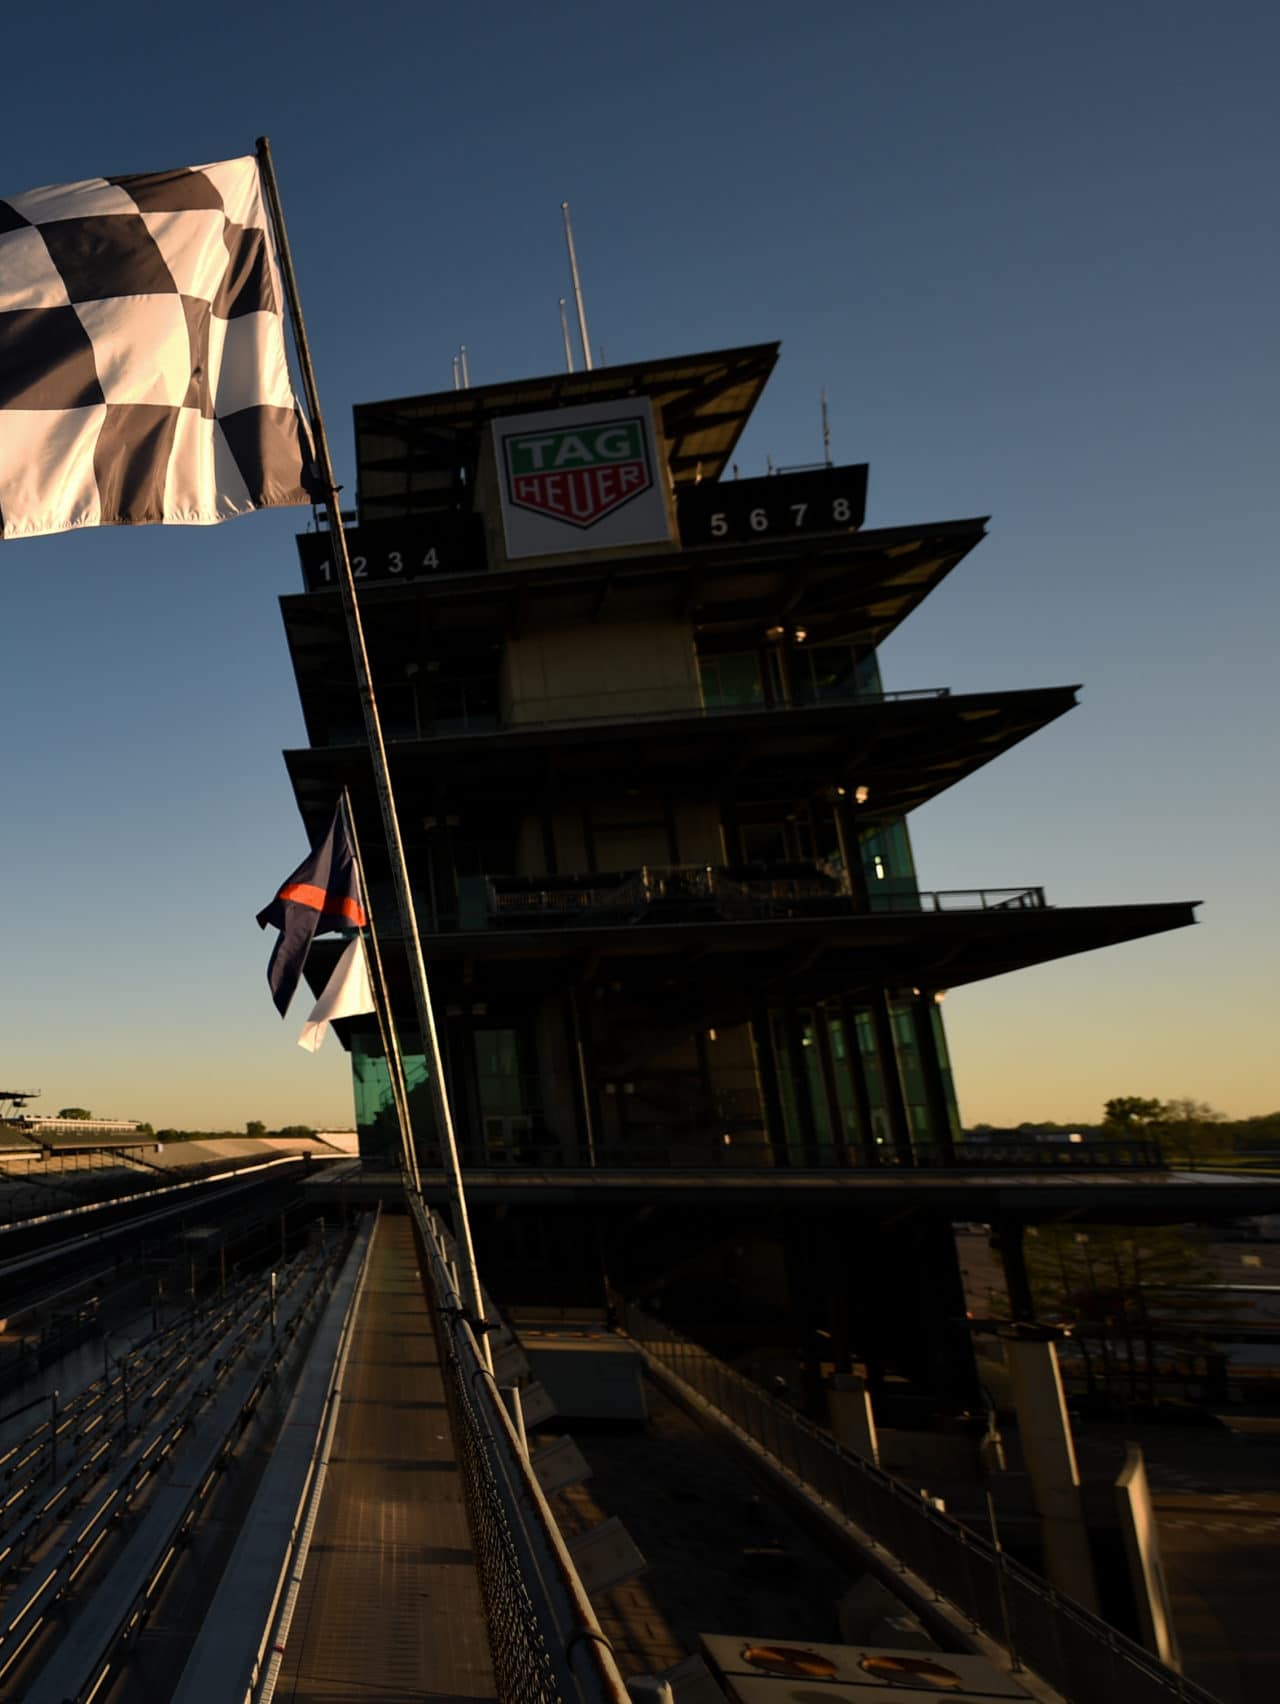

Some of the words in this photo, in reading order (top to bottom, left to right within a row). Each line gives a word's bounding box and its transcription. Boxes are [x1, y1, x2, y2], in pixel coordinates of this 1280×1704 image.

[517, 428, 632, 470] TAG
[519, 464, 641, 517] HEUER
[709, 512, 729, 537] 5
[749, 507, 769, 532] 6
[788, 502, 809, 528] 7
[831, 497, 851, 522] 8
[319, 560, 332, 582] 1
[351, 555, 369, 578] 2
[387, 551, 404, 574] 3
[422, 546, 441, 569] 4
